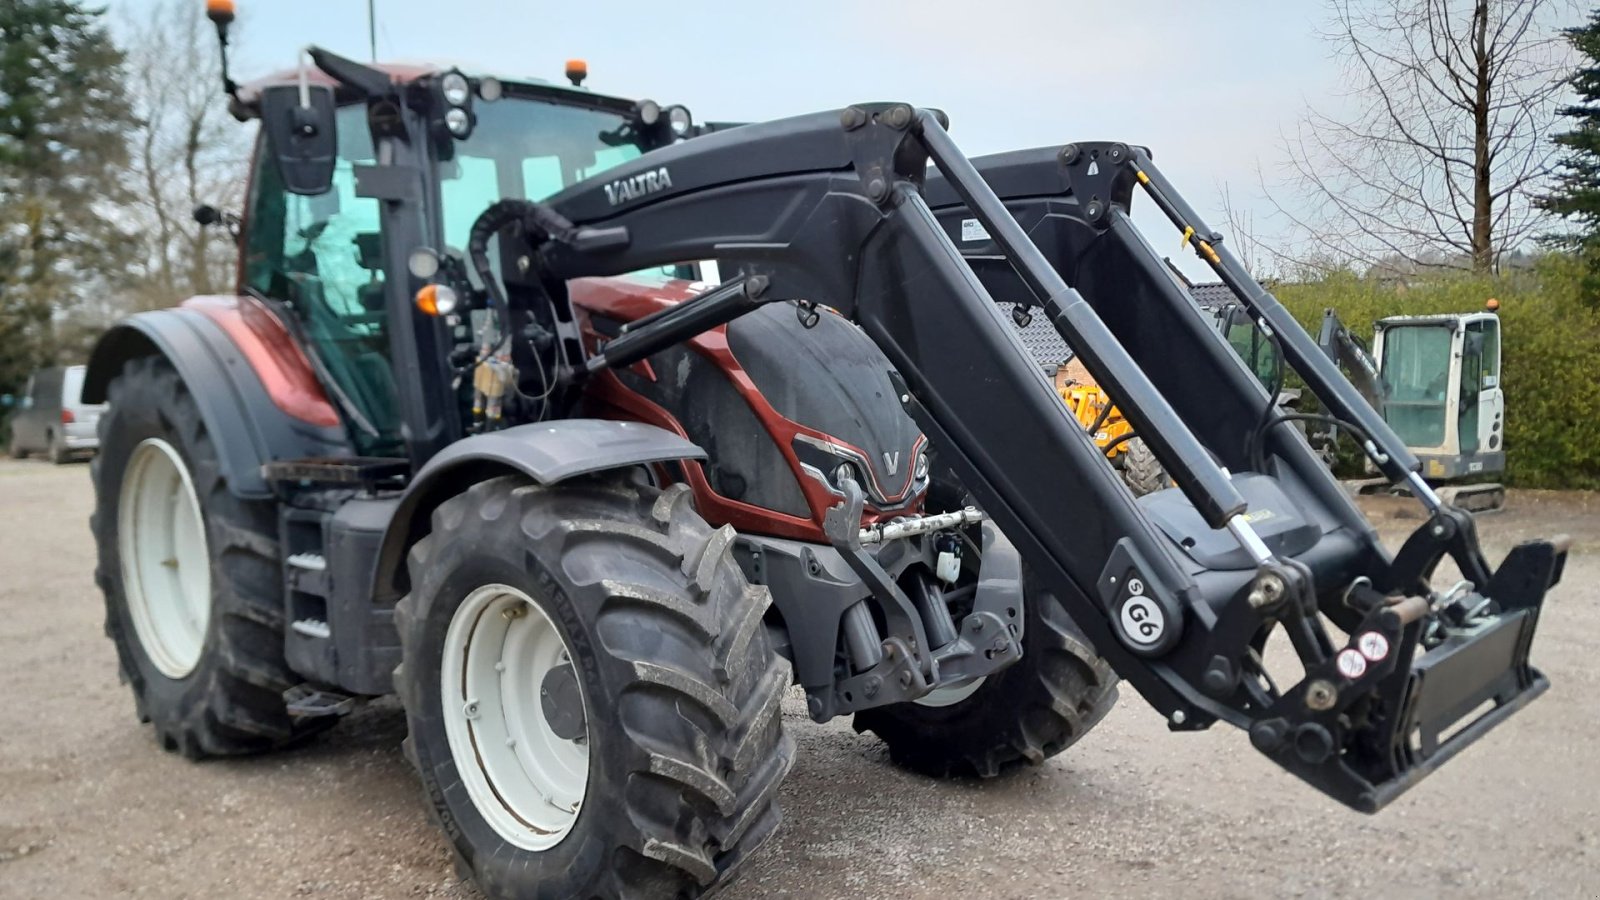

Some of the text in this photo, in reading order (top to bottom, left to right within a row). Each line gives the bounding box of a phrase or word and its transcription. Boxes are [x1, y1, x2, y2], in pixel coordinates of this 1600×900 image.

[604, 167, 673, 206] VALTRA
[1130, 582, 1142, 593] S
[1128, 603, 1160, 637] G6
